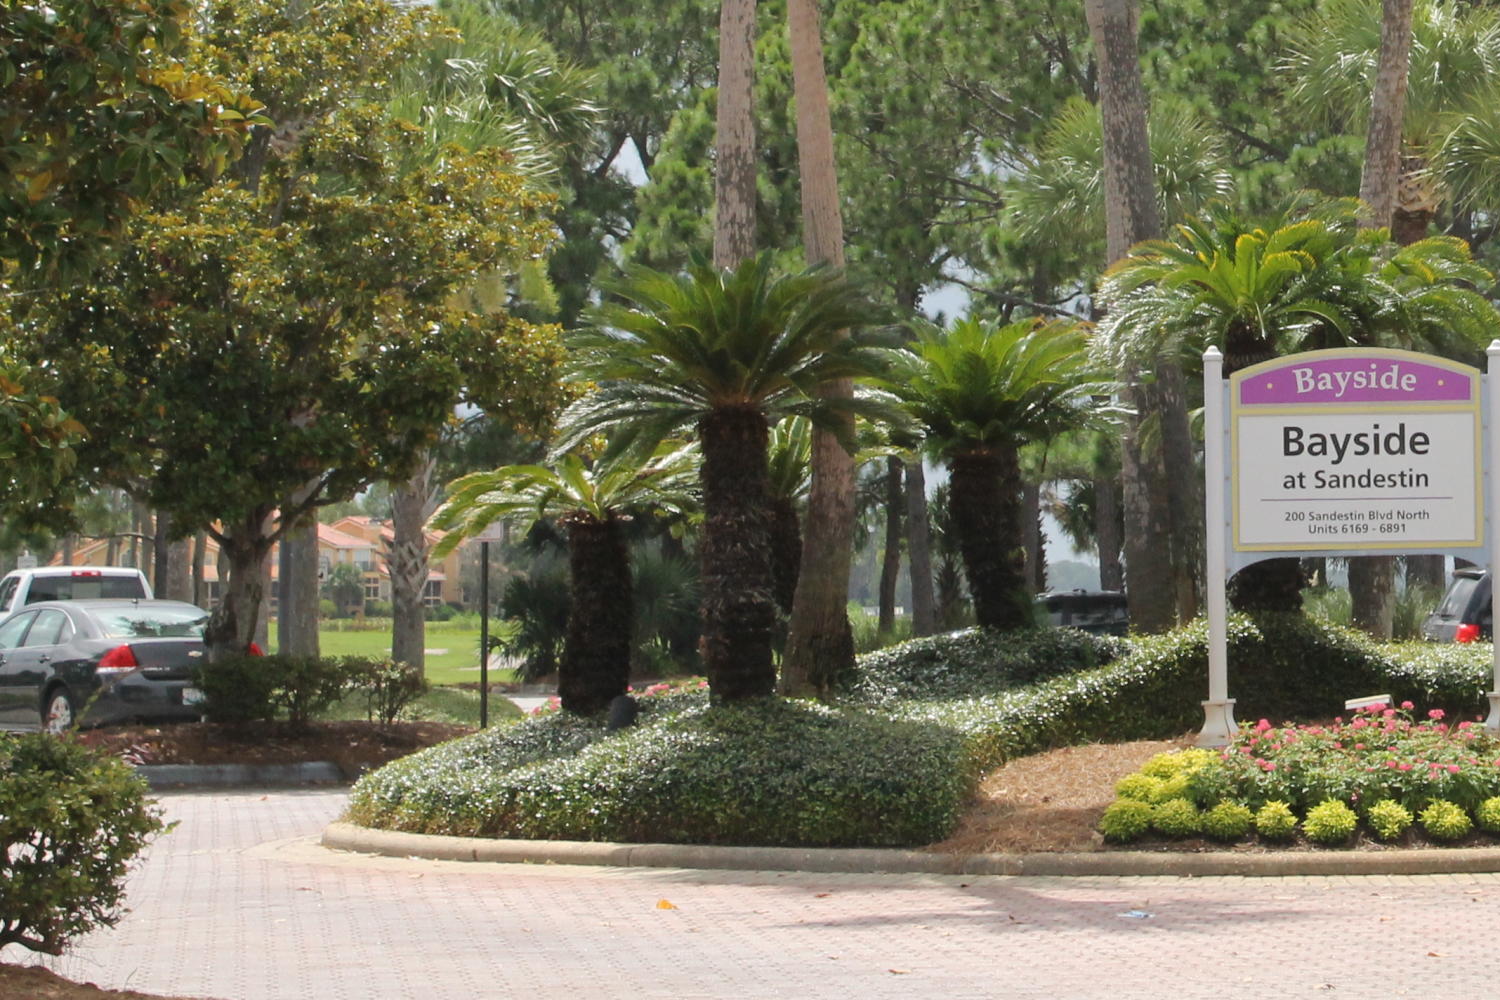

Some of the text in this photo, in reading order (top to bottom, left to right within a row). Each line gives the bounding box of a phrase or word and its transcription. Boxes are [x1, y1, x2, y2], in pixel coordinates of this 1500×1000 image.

[1292, 363, 1417, 397] Bayside
[1283, 423, 1430, 465] Bayside
[1283, 468, 1429, 489] at Sandestin
[1285, 509, 1430, 522] 200 Sandestin Blvd North
[1308, 524, 1338, 534] Units
[1341, 523, 1369, 534] 6169
[1379, 523, 1406, 534] 6891
